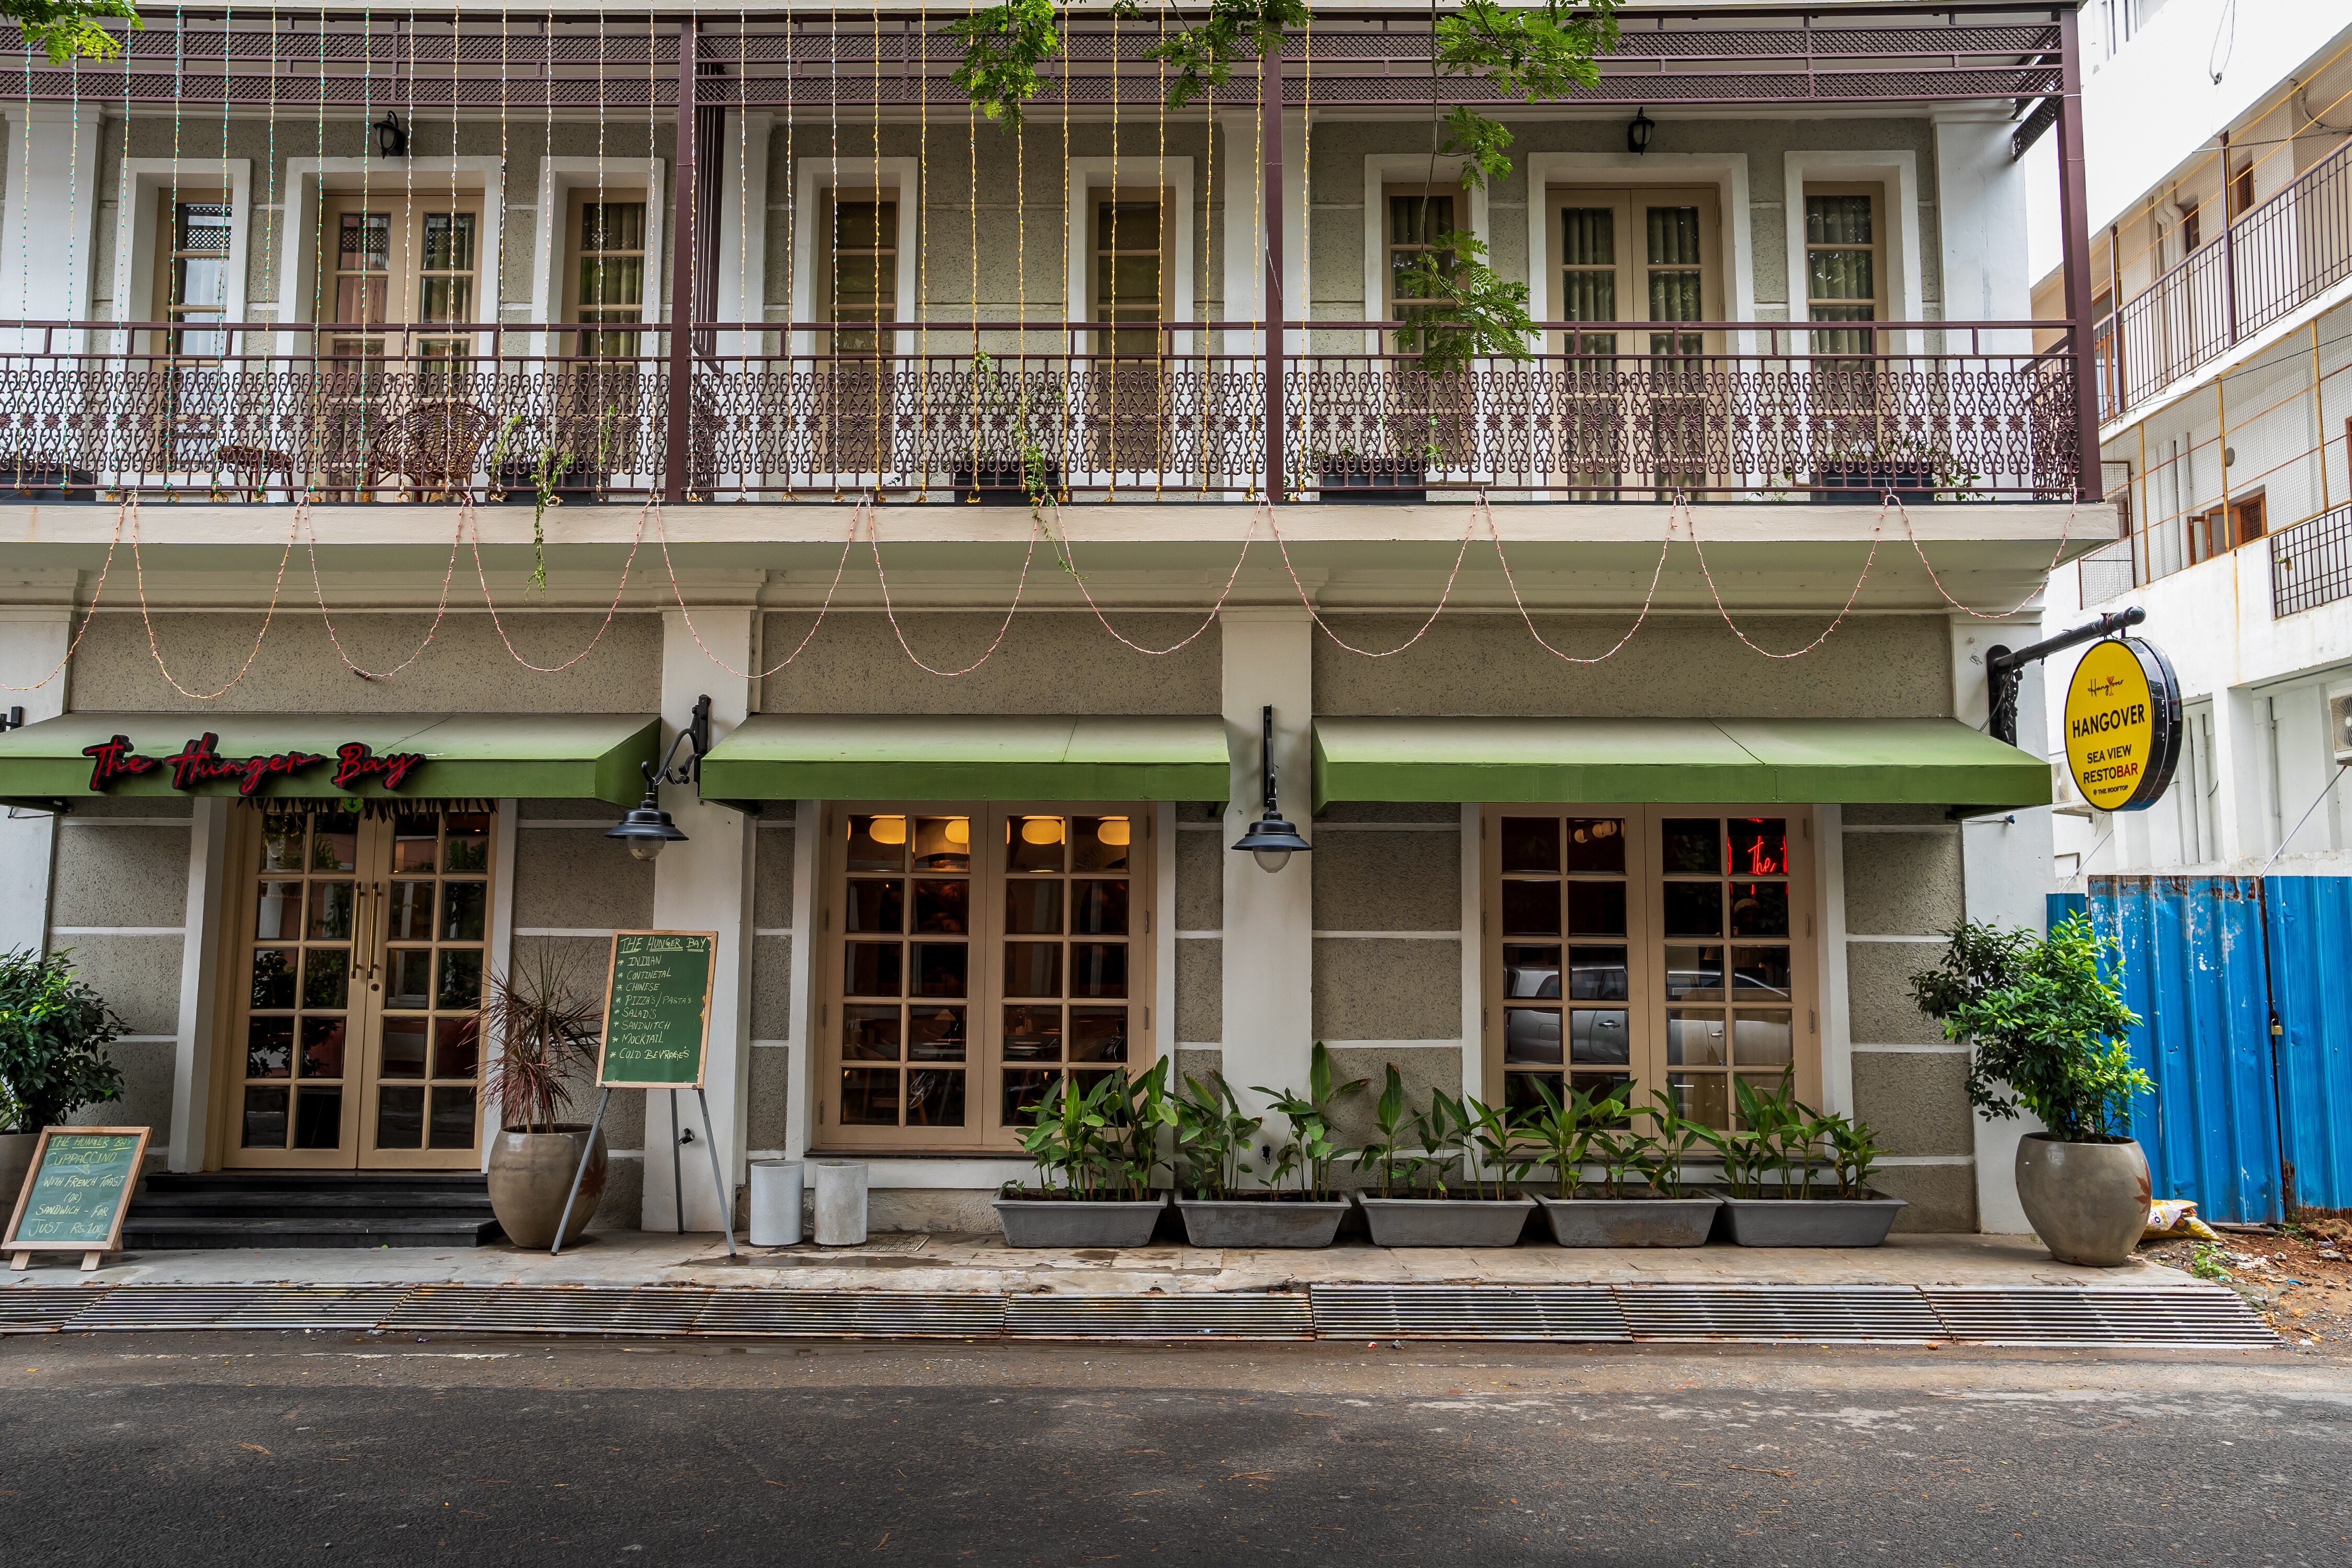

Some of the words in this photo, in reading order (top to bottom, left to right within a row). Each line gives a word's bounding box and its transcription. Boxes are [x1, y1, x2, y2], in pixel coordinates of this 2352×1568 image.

[2072, 703, 2145, 738] HANGOVER
[2087, 750, 2106, 764] SEA
[2107, 744, 2132, 760] VIEW
[84, 736, 153, 790] The
[166, 733, 320, 794] Hunger
[333, 744, 419, 790] Bay
[2083, 762, 2139, 785] RESTOBAR
[2107, 785, 2129, 793] ROOFTOP
[620, 936, 643, 952] THE
[646, 936, 681, 951] HUNGER
[686, 937, 707, 949] BAY
[627, 955, 662, 967] INDIAN
[627, 967, 672, 980] CONTINETAL
[626, 982, 661, 992] CHINESE
[621, 1007, 657, 1019] SALAD'S
[621, 1020, 671, 1030] SANDWITCH
[621, 1031, 664, 1045] MOCKTAIL
[619, 1048, 641, 1059] COLD
[50, 1135, 71, 1147] THE
[74, 1137, 110, 1147] HUNGER
[113, 1137, 134, 1147] BAY
[43, 1176, 65, 1187] WITH
[64, 1175, 99, 1187] FRENCH
[99, 1174, 126, 1188] TOAST
[35, 1203, 82, 1215] SANDWICH
[90, 1205, 109, 1218] FOR
[28, 1219, 64, 1236] JUST
